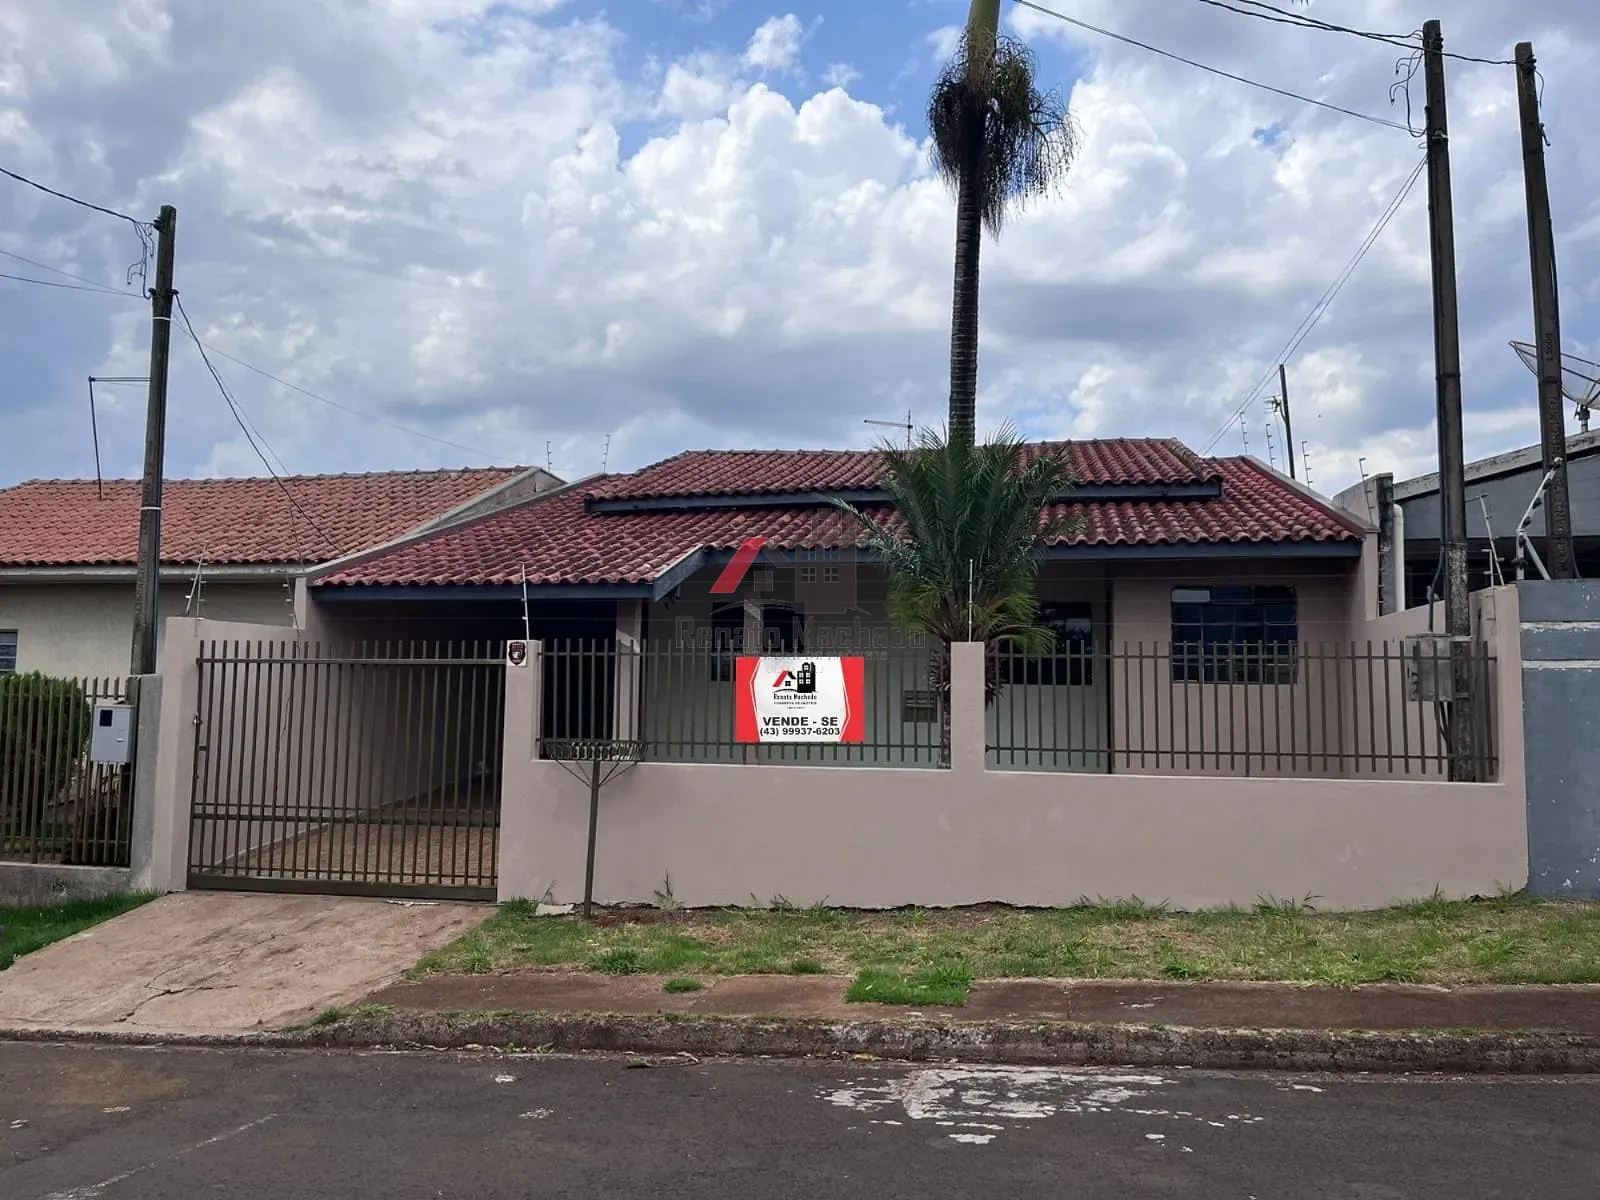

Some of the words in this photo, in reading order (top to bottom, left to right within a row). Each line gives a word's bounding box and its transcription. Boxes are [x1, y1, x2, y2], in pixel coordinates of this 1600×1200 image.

[762, 716, 809, 726] VENDE
[821, 716, 838, 726] SE
[760, 727, 779, 736] (43)
[782, 727, 840, 736] 99937-6203
